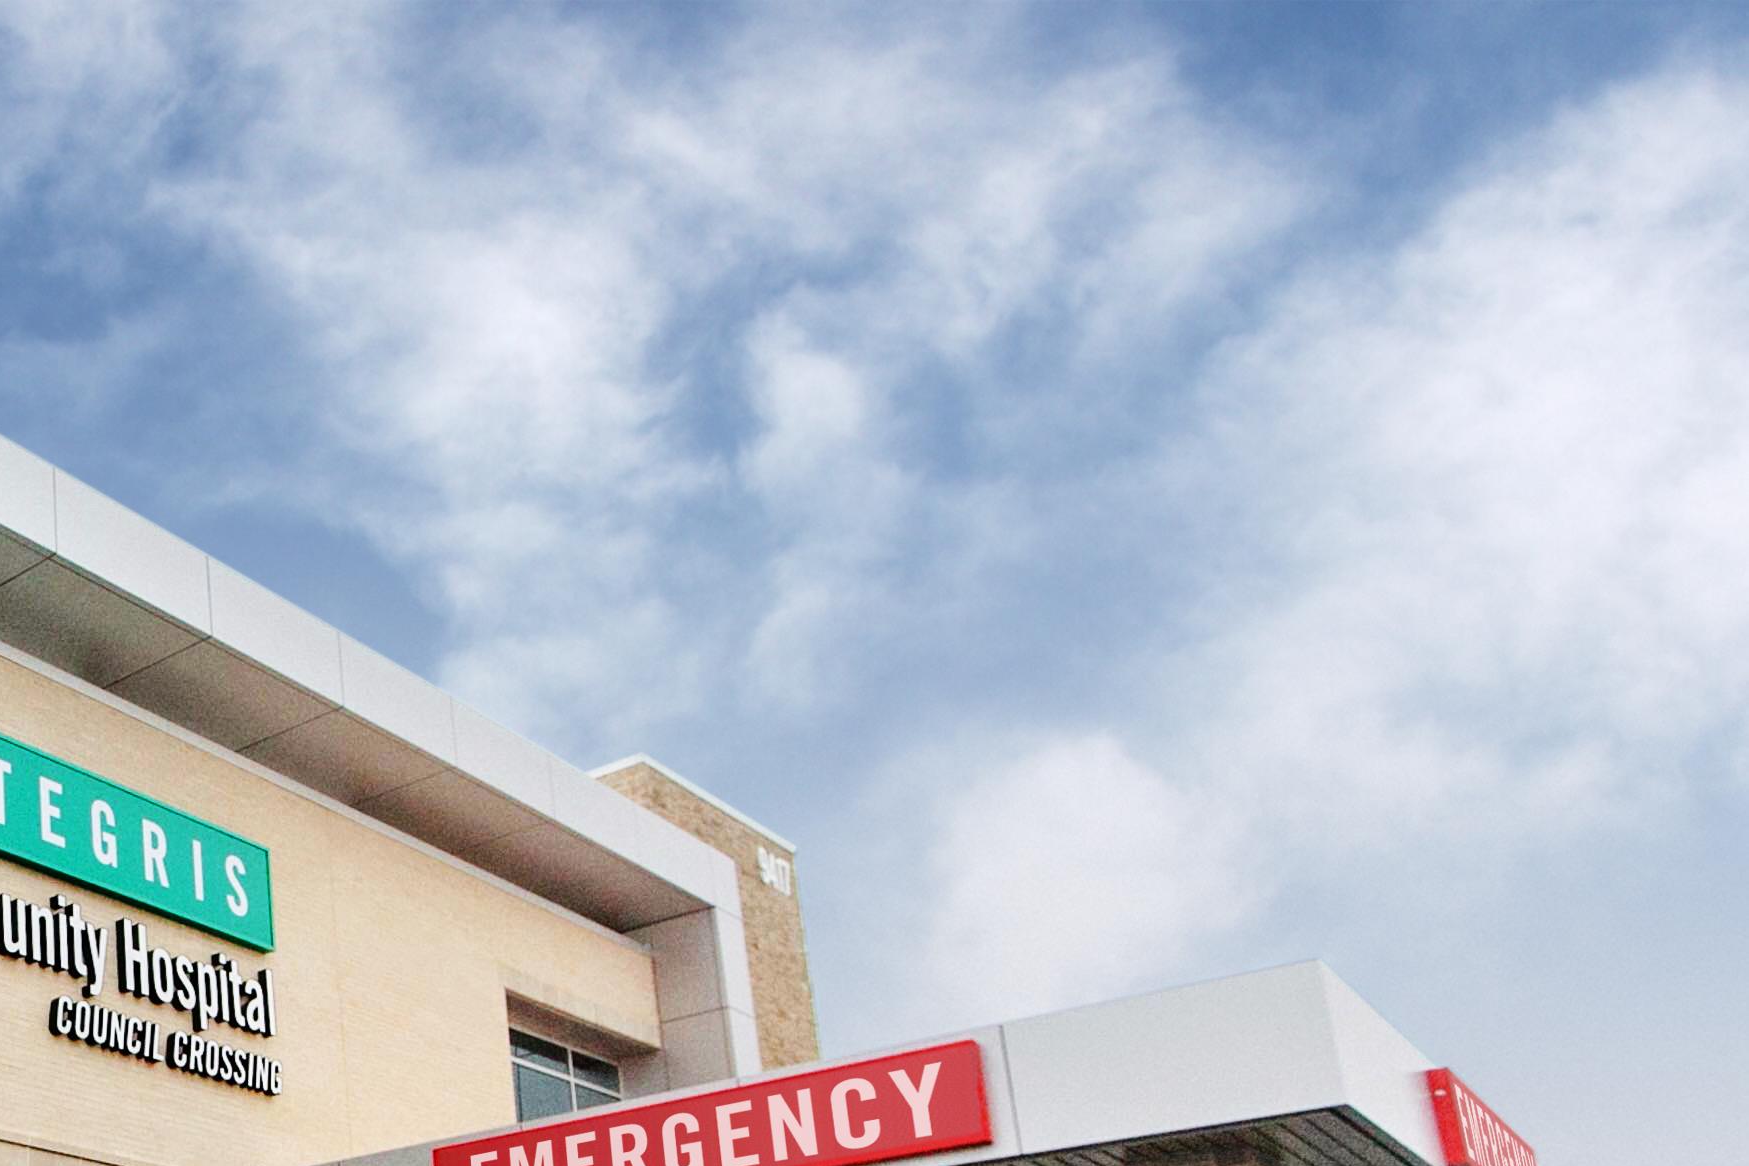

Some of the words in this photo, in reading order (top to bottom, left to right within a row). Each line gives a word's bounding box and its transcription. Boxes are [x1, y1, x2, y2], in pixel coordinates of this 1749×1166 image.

[117, 917, 276, 1037] Hospital
[49, 995, 165, 1063] COUNCIL
[167, 1031, 283, 1097] CROSSING
